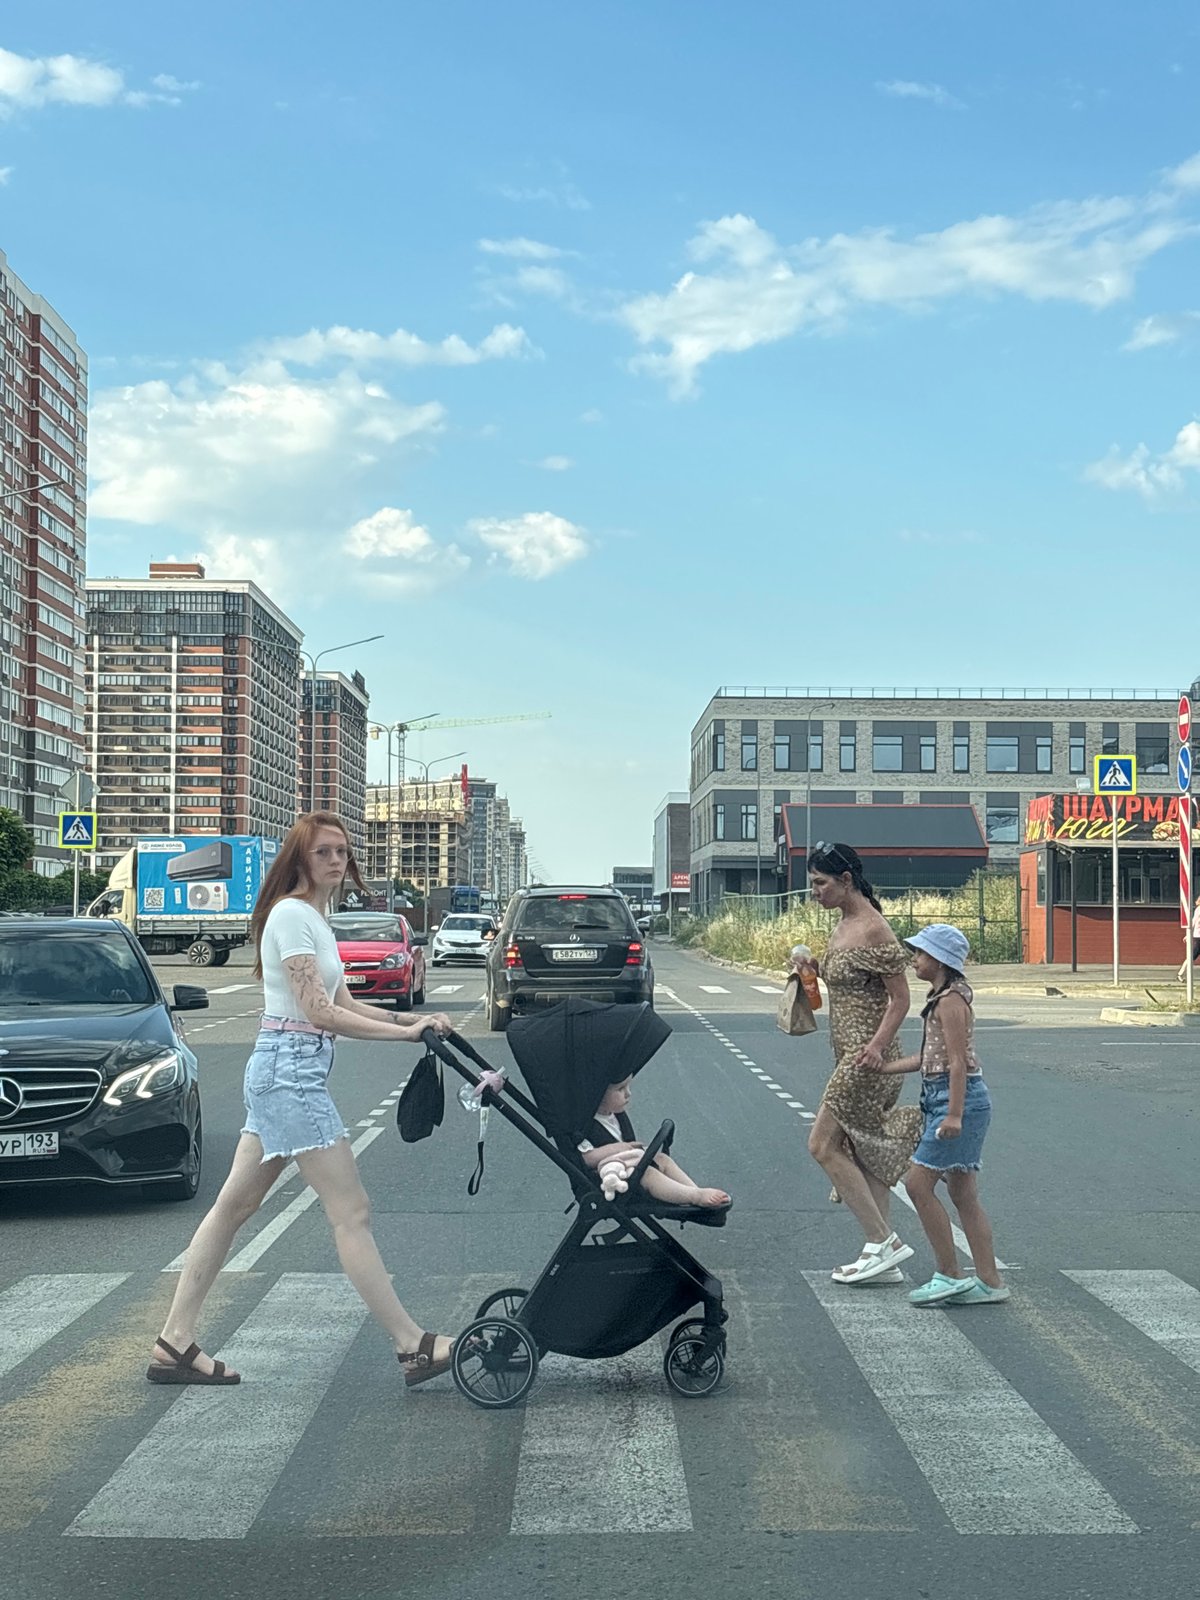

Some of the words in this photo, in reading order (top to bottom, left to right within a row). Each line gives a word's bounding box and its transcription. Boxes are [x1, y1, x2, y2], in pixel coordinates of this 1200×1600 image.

[1063, 796, 1180, 822] ШАУРМА
[245, 847, 253, 911] АВИАТОР
[27, 1133, 53, 1148] 193
